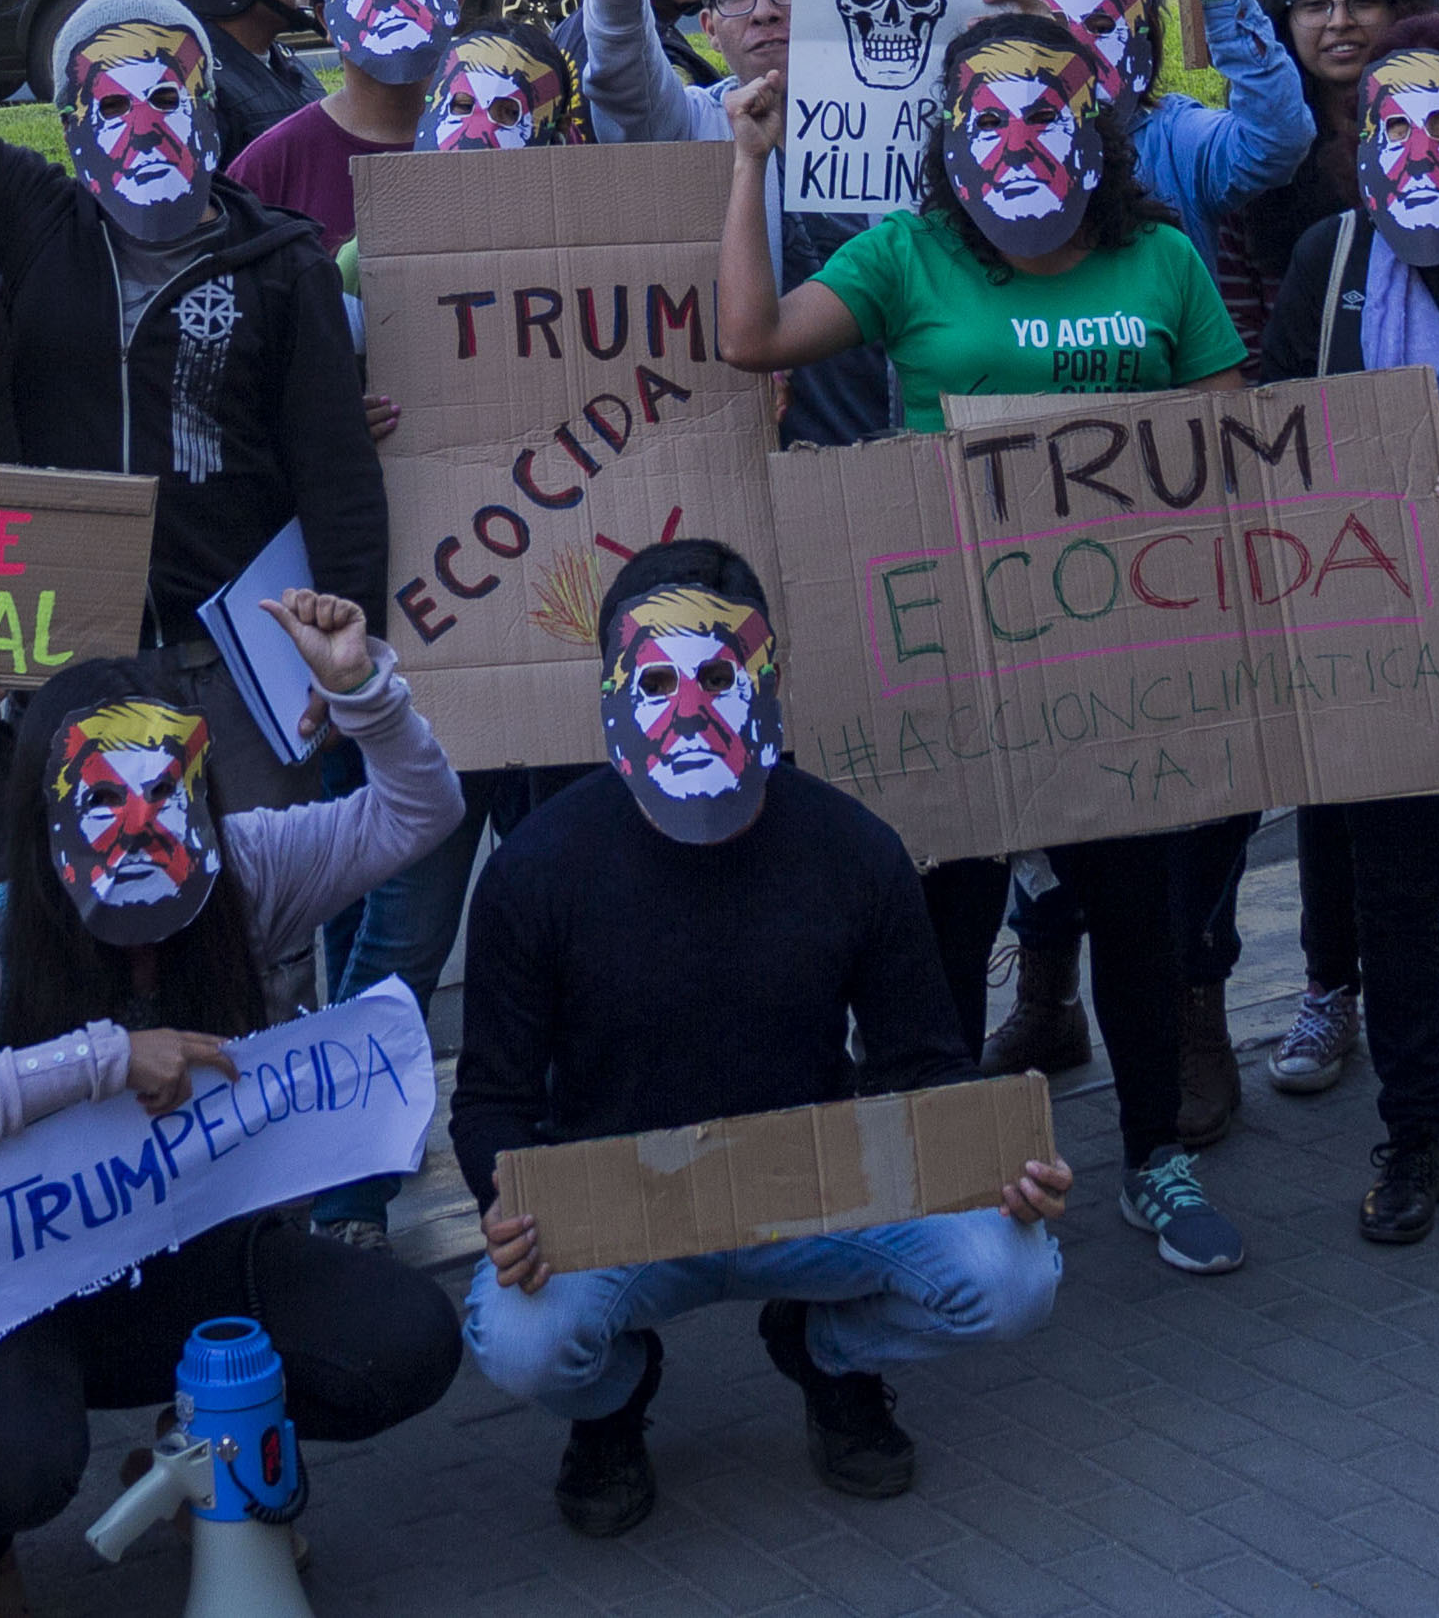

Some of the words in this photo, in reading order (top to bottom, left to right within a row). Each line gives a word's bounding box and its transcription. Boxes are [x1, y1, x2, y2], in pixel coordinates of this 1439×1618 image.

[796, 98, 866, 142] YOU
[893, 99, 938, 142] AR
[437, 281, 729, 363] TRUM
[1011, 318, 1049, 348] YO
[1057, 311, 1147, 348] ACTÚO
[1053, 349, 1108, 382] POR
[1117, 349, 1142, 383] EL
[395, 364, 692, 645] ECOCIDA
[965, 404, 1312, 523] TRUM
[882, 512, 1412, 663] ECOCIDA
